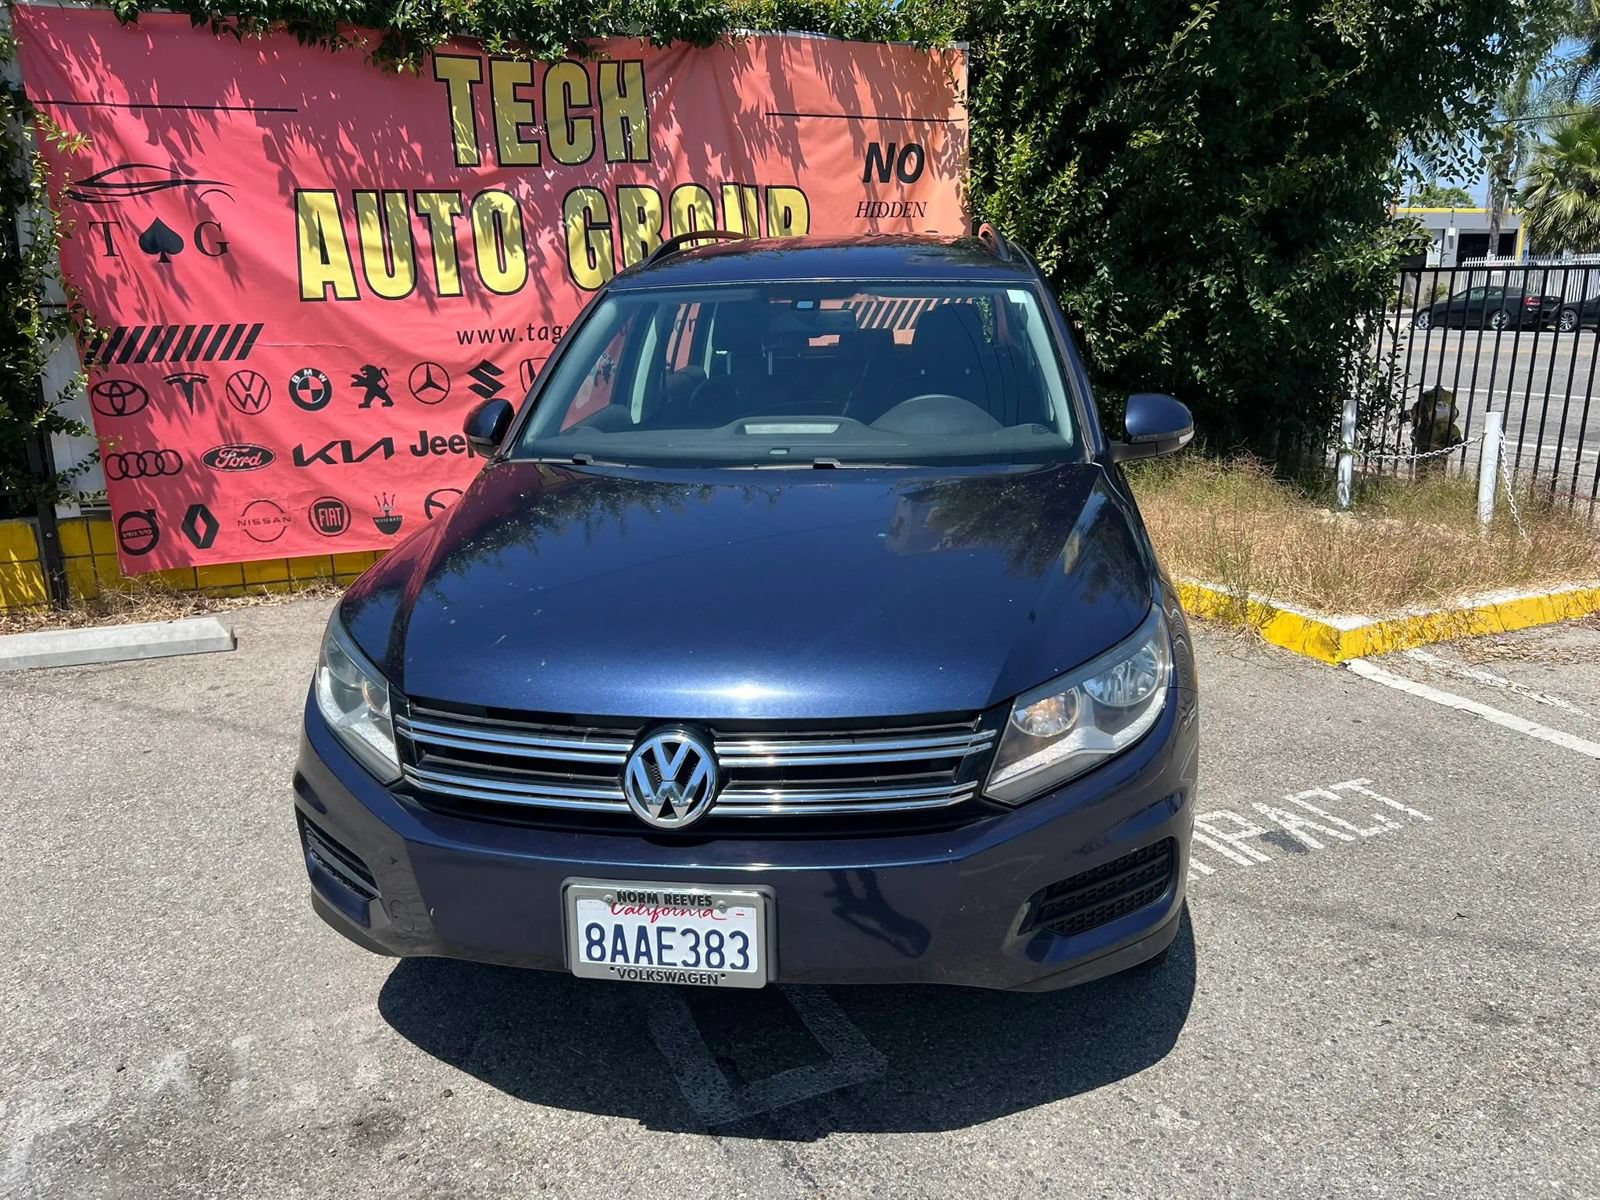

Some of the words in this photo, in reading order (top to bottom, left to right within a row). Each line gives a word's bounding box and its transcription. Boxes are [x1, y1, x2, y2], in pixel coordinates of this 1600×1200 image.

[435, 54, 650, 167] TECH
[862, 142, 925, 184] NO
[855, 201, 928, 218] HIDDEN
[295, 188, 529, 302] AUTO
[456, 323, 570, 345] www.tag
[291, 368, 327, 384] BMW
[215, 447, 262, 468] Ford
[292, 437, 395, 467] KIA
[237, 516, 292, 527] NISSAN
[318, 507, 342, 527] FIAT
[616, 891, 659, 905] NORM
[663, 893, 713, 907] REEVES
[610, 901, 727, 923] California
[585, 922, 750, 970] 8AAE383
[616, 967, 719, 985] VOLKSWAGEN
